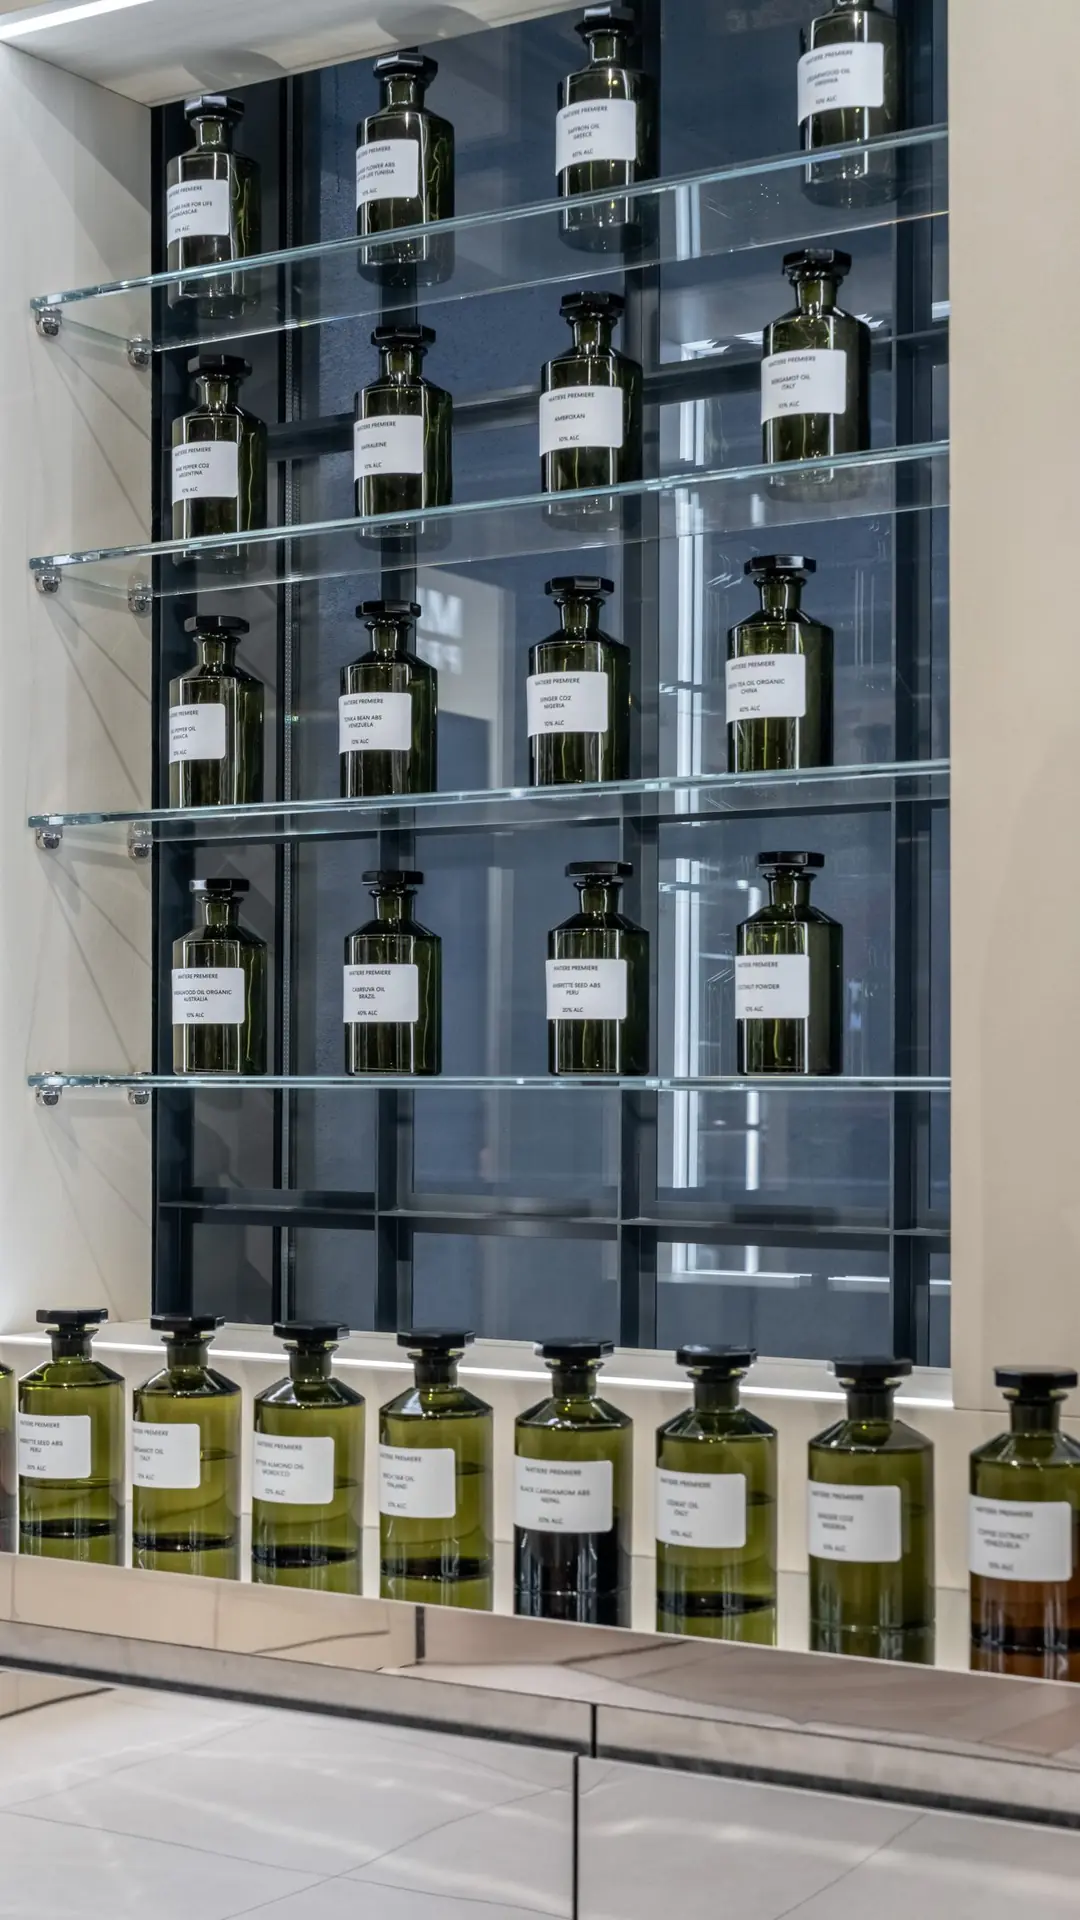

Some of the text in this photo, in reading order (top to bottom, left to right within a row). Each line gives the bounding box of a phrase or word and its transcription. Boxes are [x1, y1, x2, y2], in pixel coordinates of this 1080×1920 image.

[581, 105, 608, 113] PREMIERE
[788, 355, 816, 363] PREMIERE
[781, 382, 797, 391] ITALY
[567, 391, 595, 399] PREMIERE
[789, 400, 800, 408] ALC
[371, 420, 396, 428] PREMIERE
[748, 660, 776, 668] PREMIERE
[553, 676, 580, 684] PREMIERE
[359, 697, 384, 705] PREMIERE
[559, 694, 572, 702] CO2
[371, 713, 383, 721] ABS
[193, 972, 218, 980] PREMIERE
[206, 988, 232, 996] ORGANIC
[34, 1421, 60, 1429] PREMIERE
[549, 1468, 582, 1477] PREMIERE
